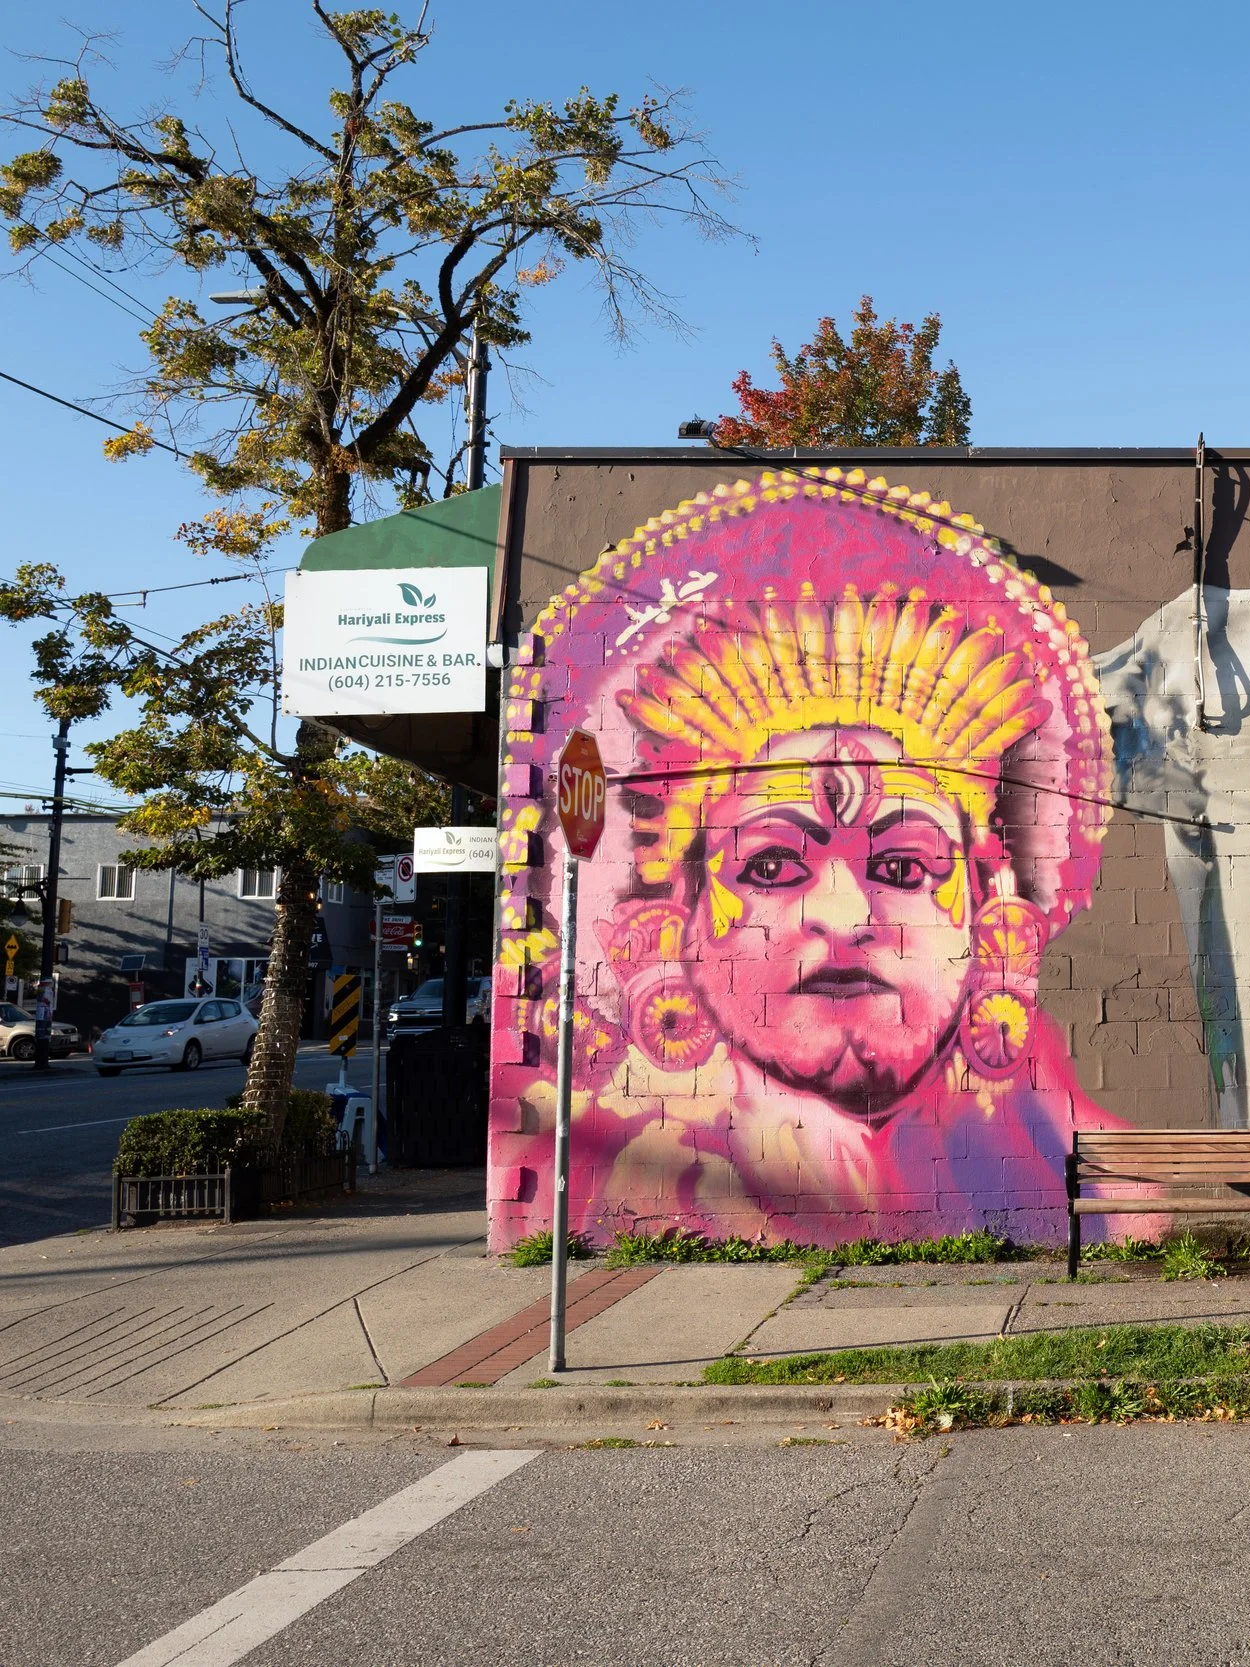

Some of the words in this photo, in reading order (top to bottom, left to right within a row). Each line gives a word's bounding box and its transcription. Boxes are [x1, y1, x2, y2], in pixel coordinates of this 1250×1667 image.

[338, 613, 391, 626] Hariyali
[395, 612, 445, 626] Express
[426, 655, 437, 667] &
[328, 675, 370, 692] (604)
[375, 672, 451, 687] 215-7556
[561, 763, 604, 822] STOP
[419, 848, 441, 856] Hariyali
[468, 849, 494, 860] (604)
